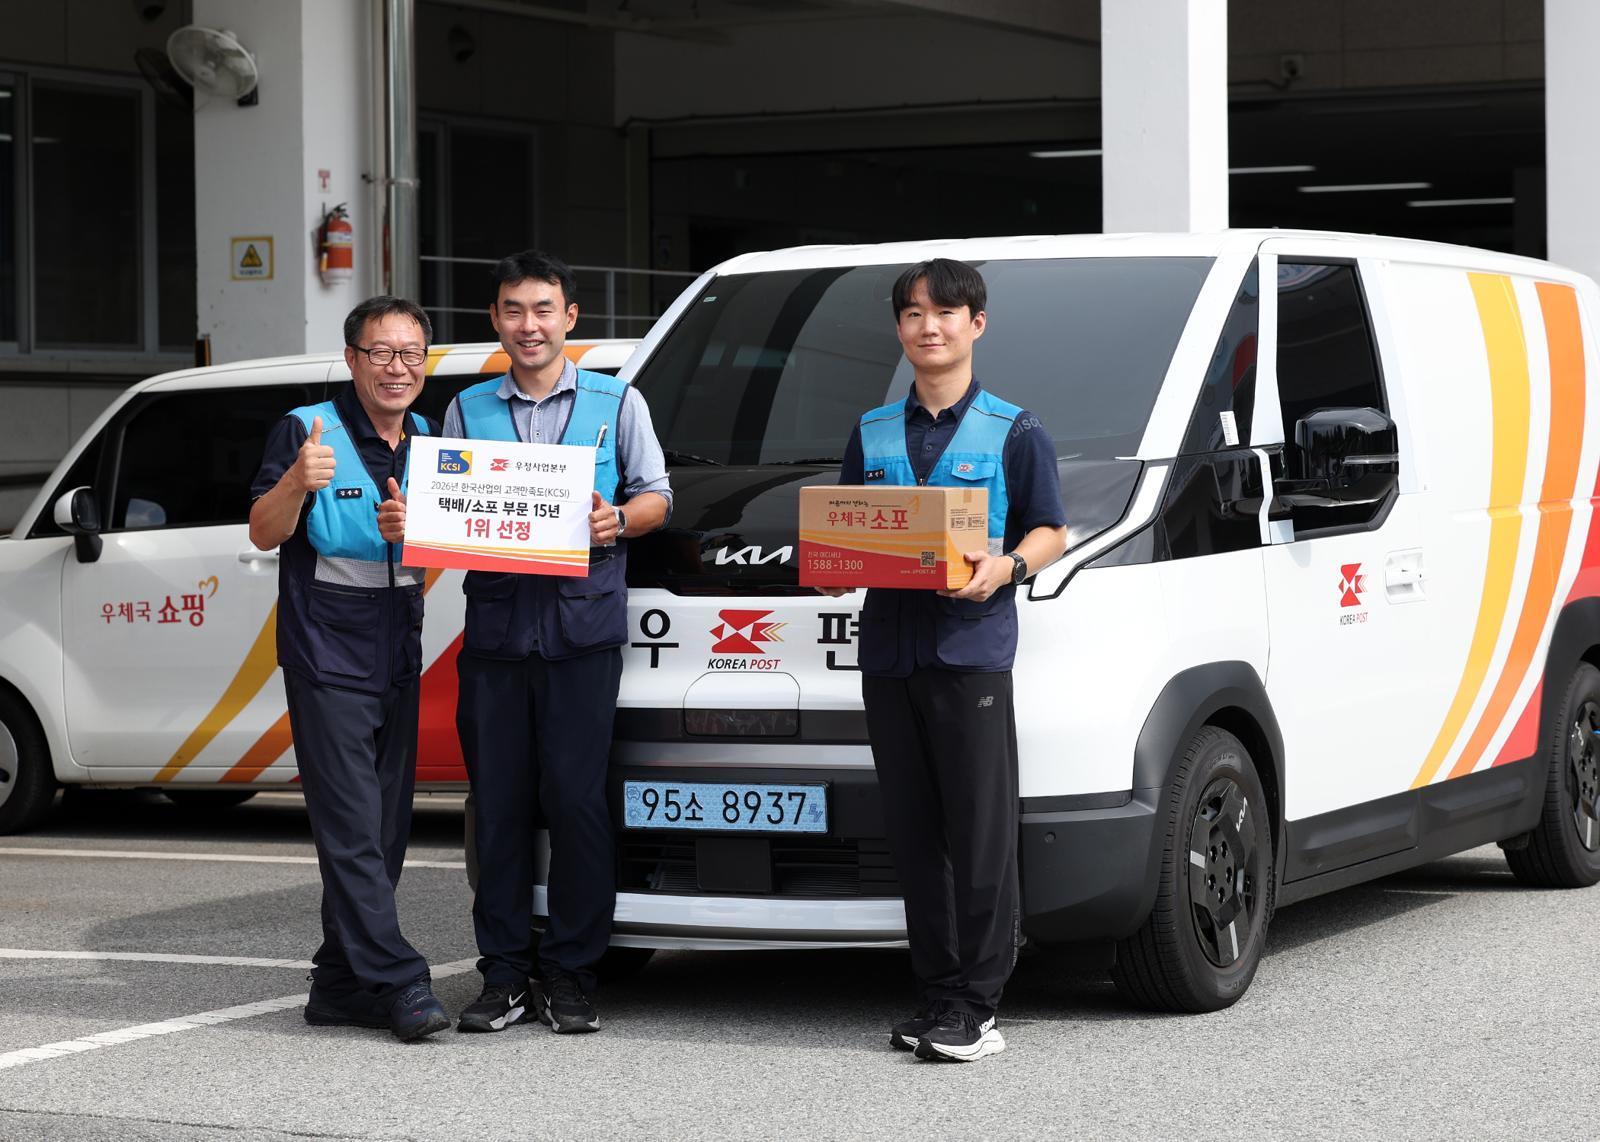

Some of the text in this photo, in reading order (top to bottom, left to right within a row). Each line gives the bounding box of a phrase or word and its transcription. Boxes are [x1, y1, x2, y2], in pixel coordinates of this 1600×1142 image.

[440, 462, 461, 472] KCSI
[515, 461, 567, 473] 우정사업본부
[431, 481, 570, 499] 2026년 한국산업의 고객만족도(KCSI)
[438, 497, 560, 519] 택배/소포 부문 15년
[464, 518, 531, 541] 1위 선정
[826, 509, 909, 530] 우체국 소포
[715, 545, 793, 566] KIA
[808, 559, 863, 570] 1588-1300
[100, 594, 204, 627] 우체국 쇼핑
[631, 608, 679, 668] 우
[707, 658, 781, 670] KOREA POST
[641, 788, 807, 825] 95소 8937
